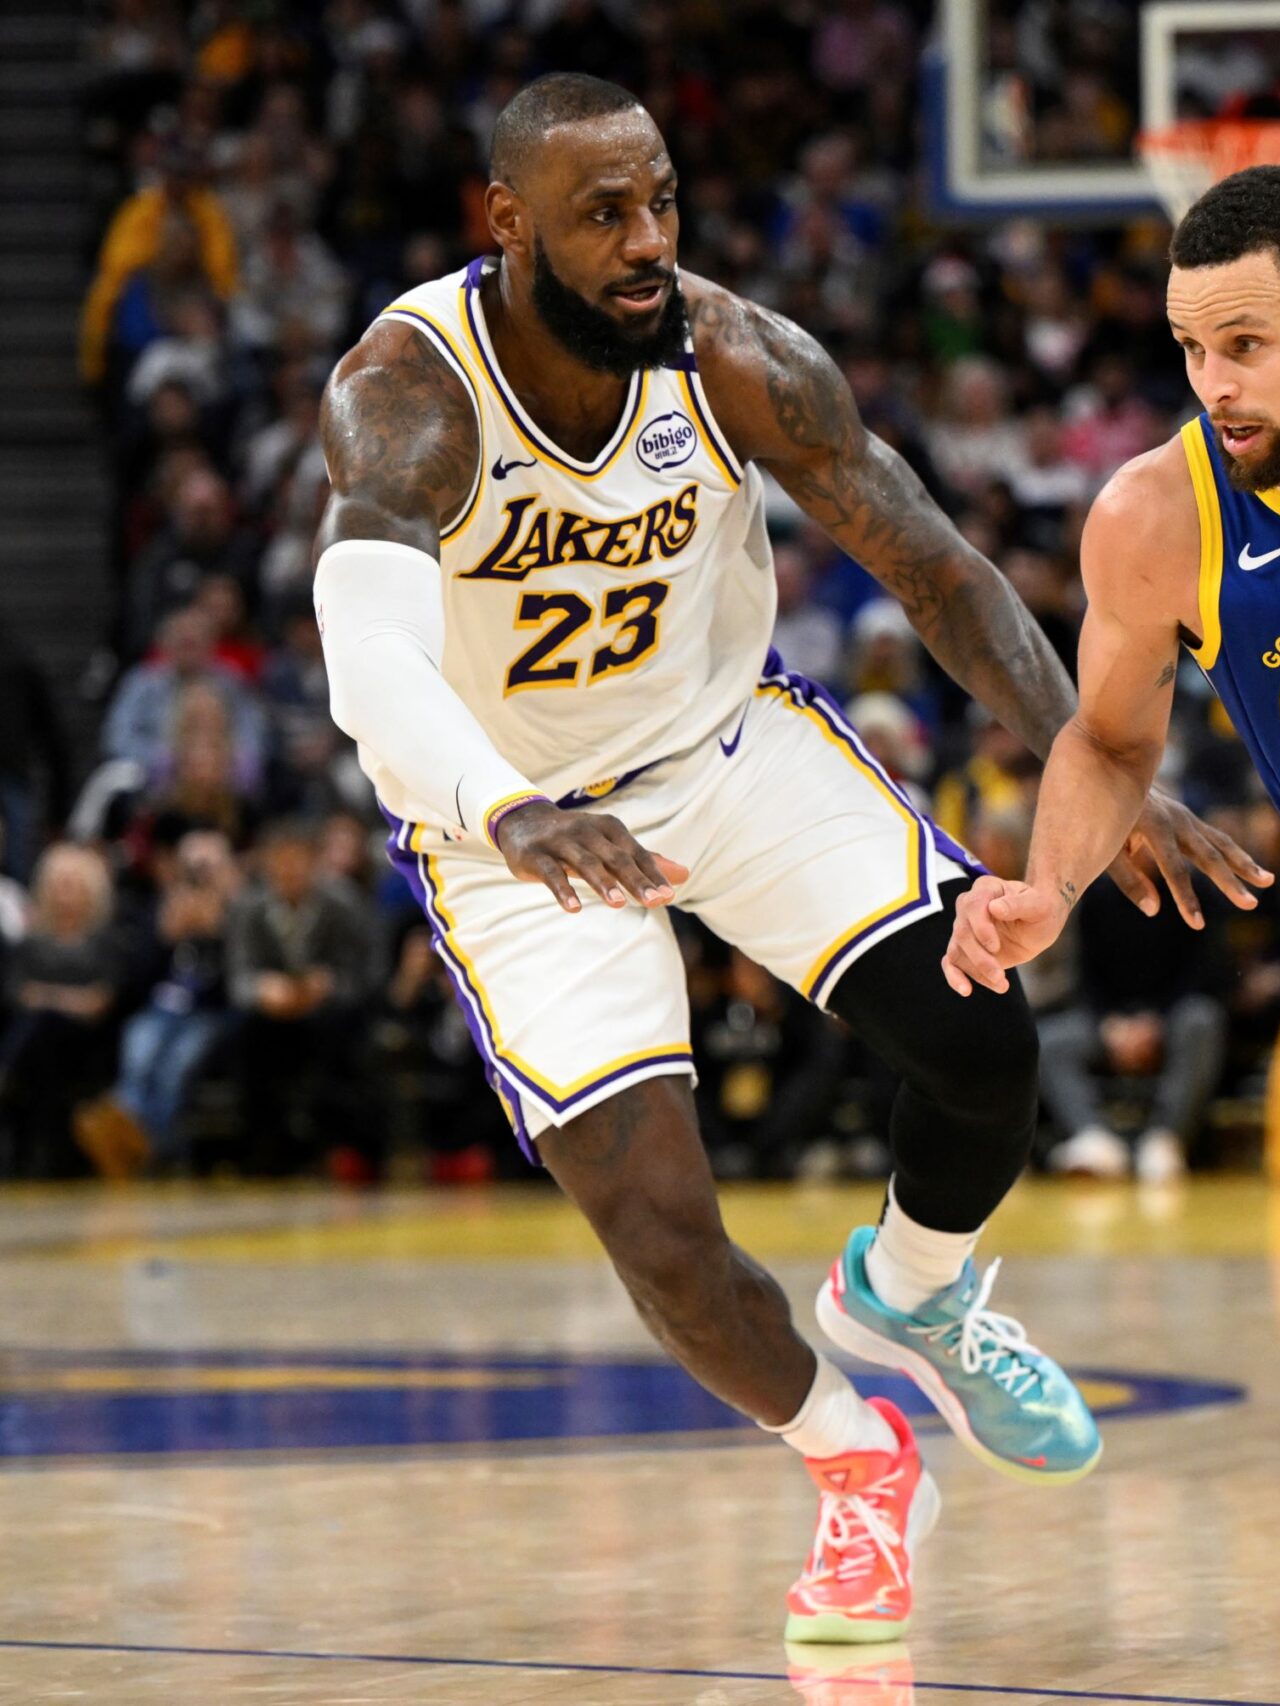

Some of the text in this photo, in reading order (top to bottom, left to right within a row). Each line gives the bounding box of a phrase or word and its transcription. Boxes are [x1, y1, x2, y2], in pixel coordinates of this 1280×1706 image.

[642, 426, 693, 455] bibigo
[654, 446, 678, 460] 비비고
[453, 482, 699, 581] LAKERS
[503, 577, 672, 700] 23
